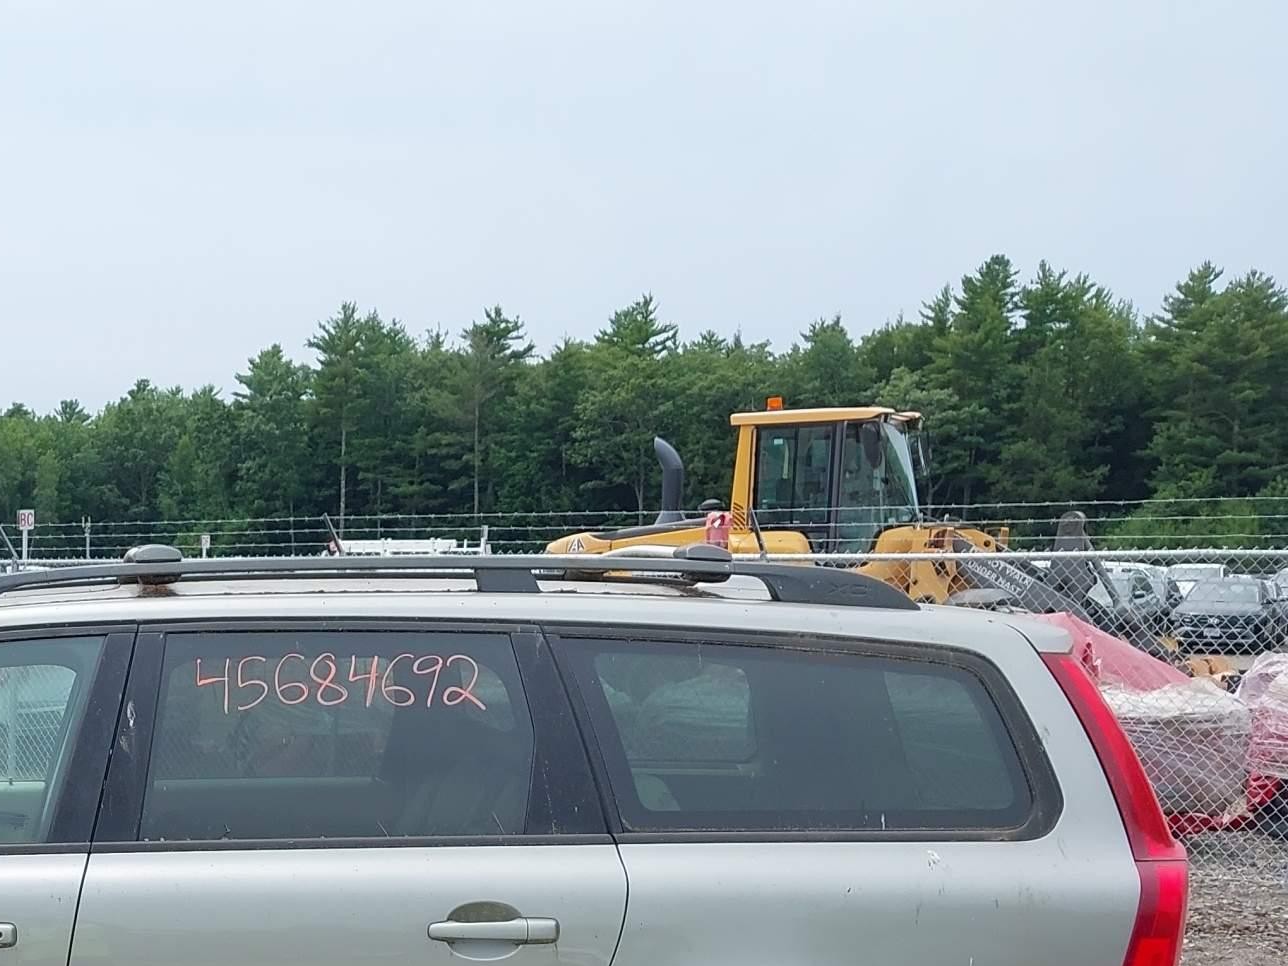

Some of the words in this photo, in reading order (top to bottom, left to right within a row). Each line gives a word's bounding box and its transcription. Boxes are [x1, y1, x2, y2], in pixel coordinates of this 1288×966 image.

[20, 511, 34, 528] BC
[967, 560, 998, 580] UNDER
[1005, 566, 1031, 586] WALK
[196, 652, 487, 714] 45684692
